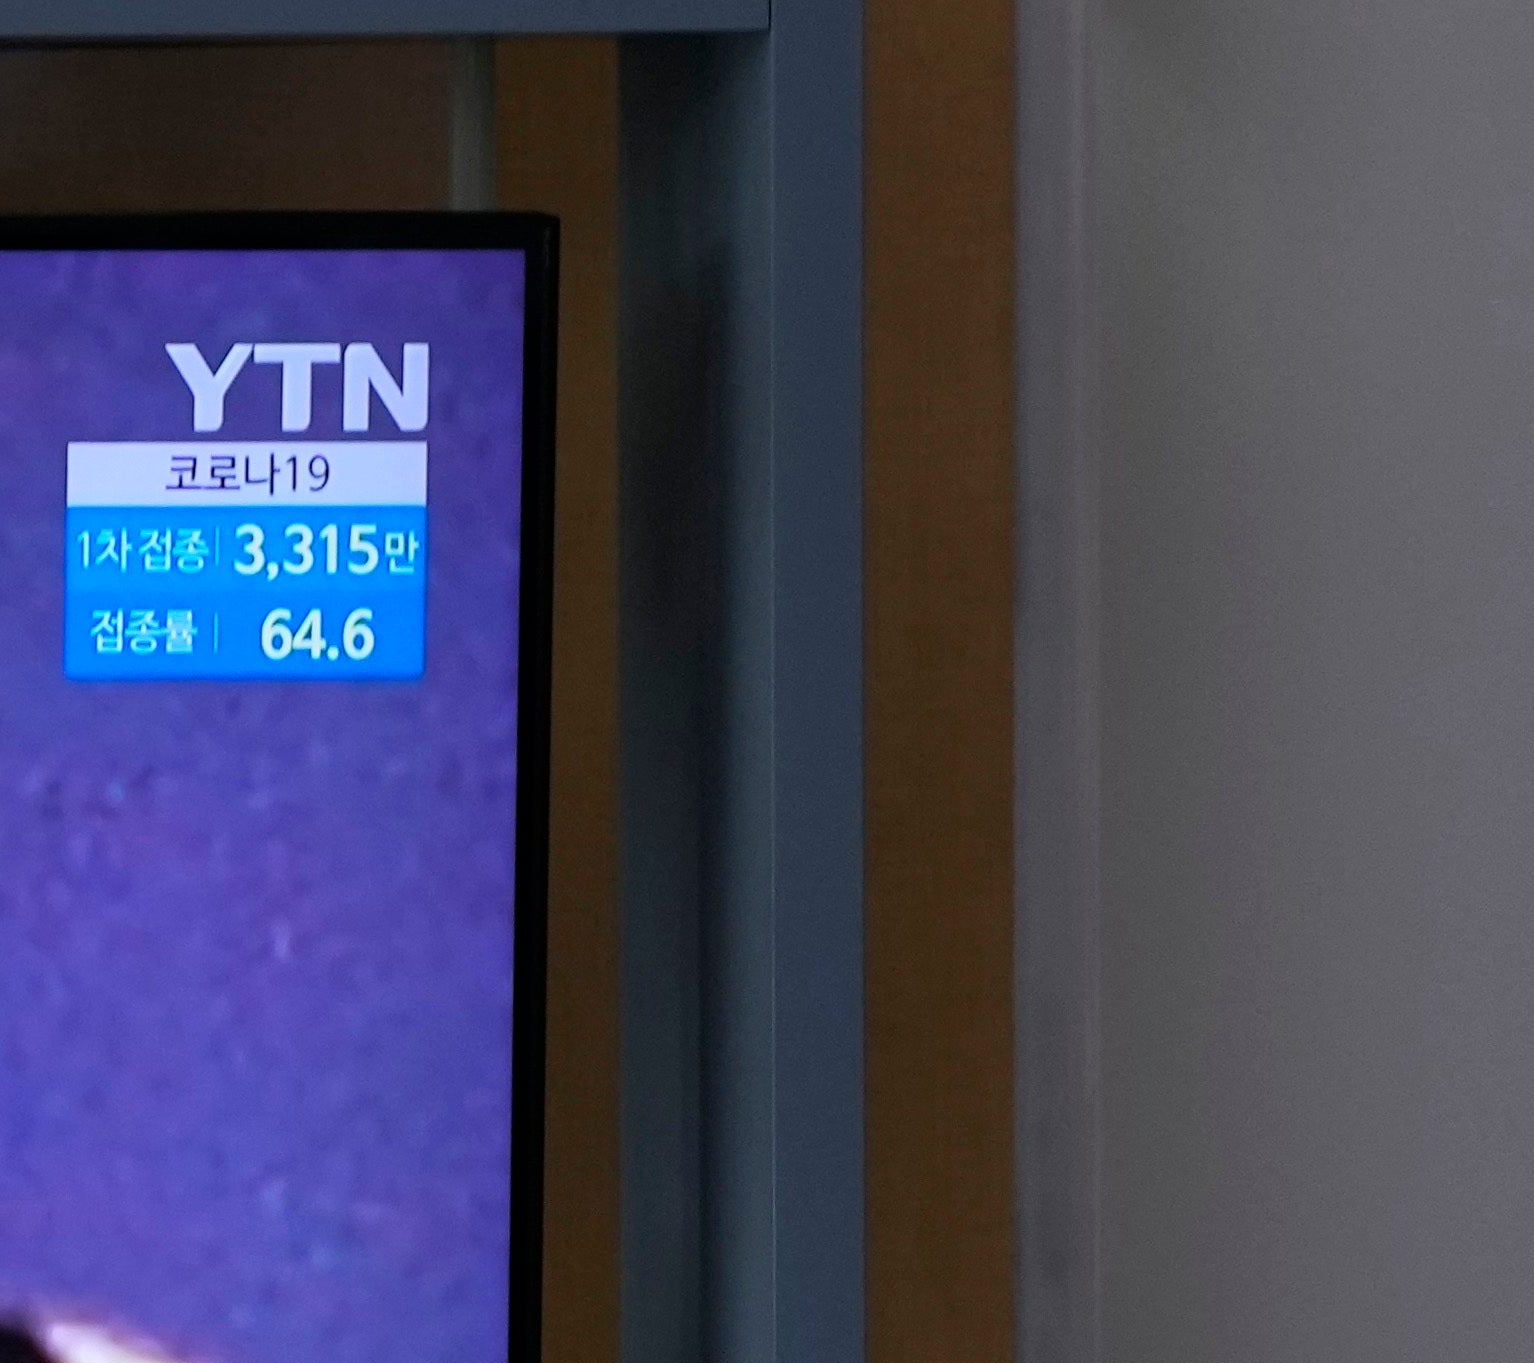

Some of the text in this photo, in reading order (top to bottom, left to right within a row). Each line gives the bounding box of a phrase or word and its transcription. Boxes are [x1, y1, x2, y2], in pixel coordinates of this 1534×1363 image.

[165, 342, 430, 433] YTN
[165, 453, 331, 497] 코로나19
[90, 607, 375, 661] 접종률 64.6
